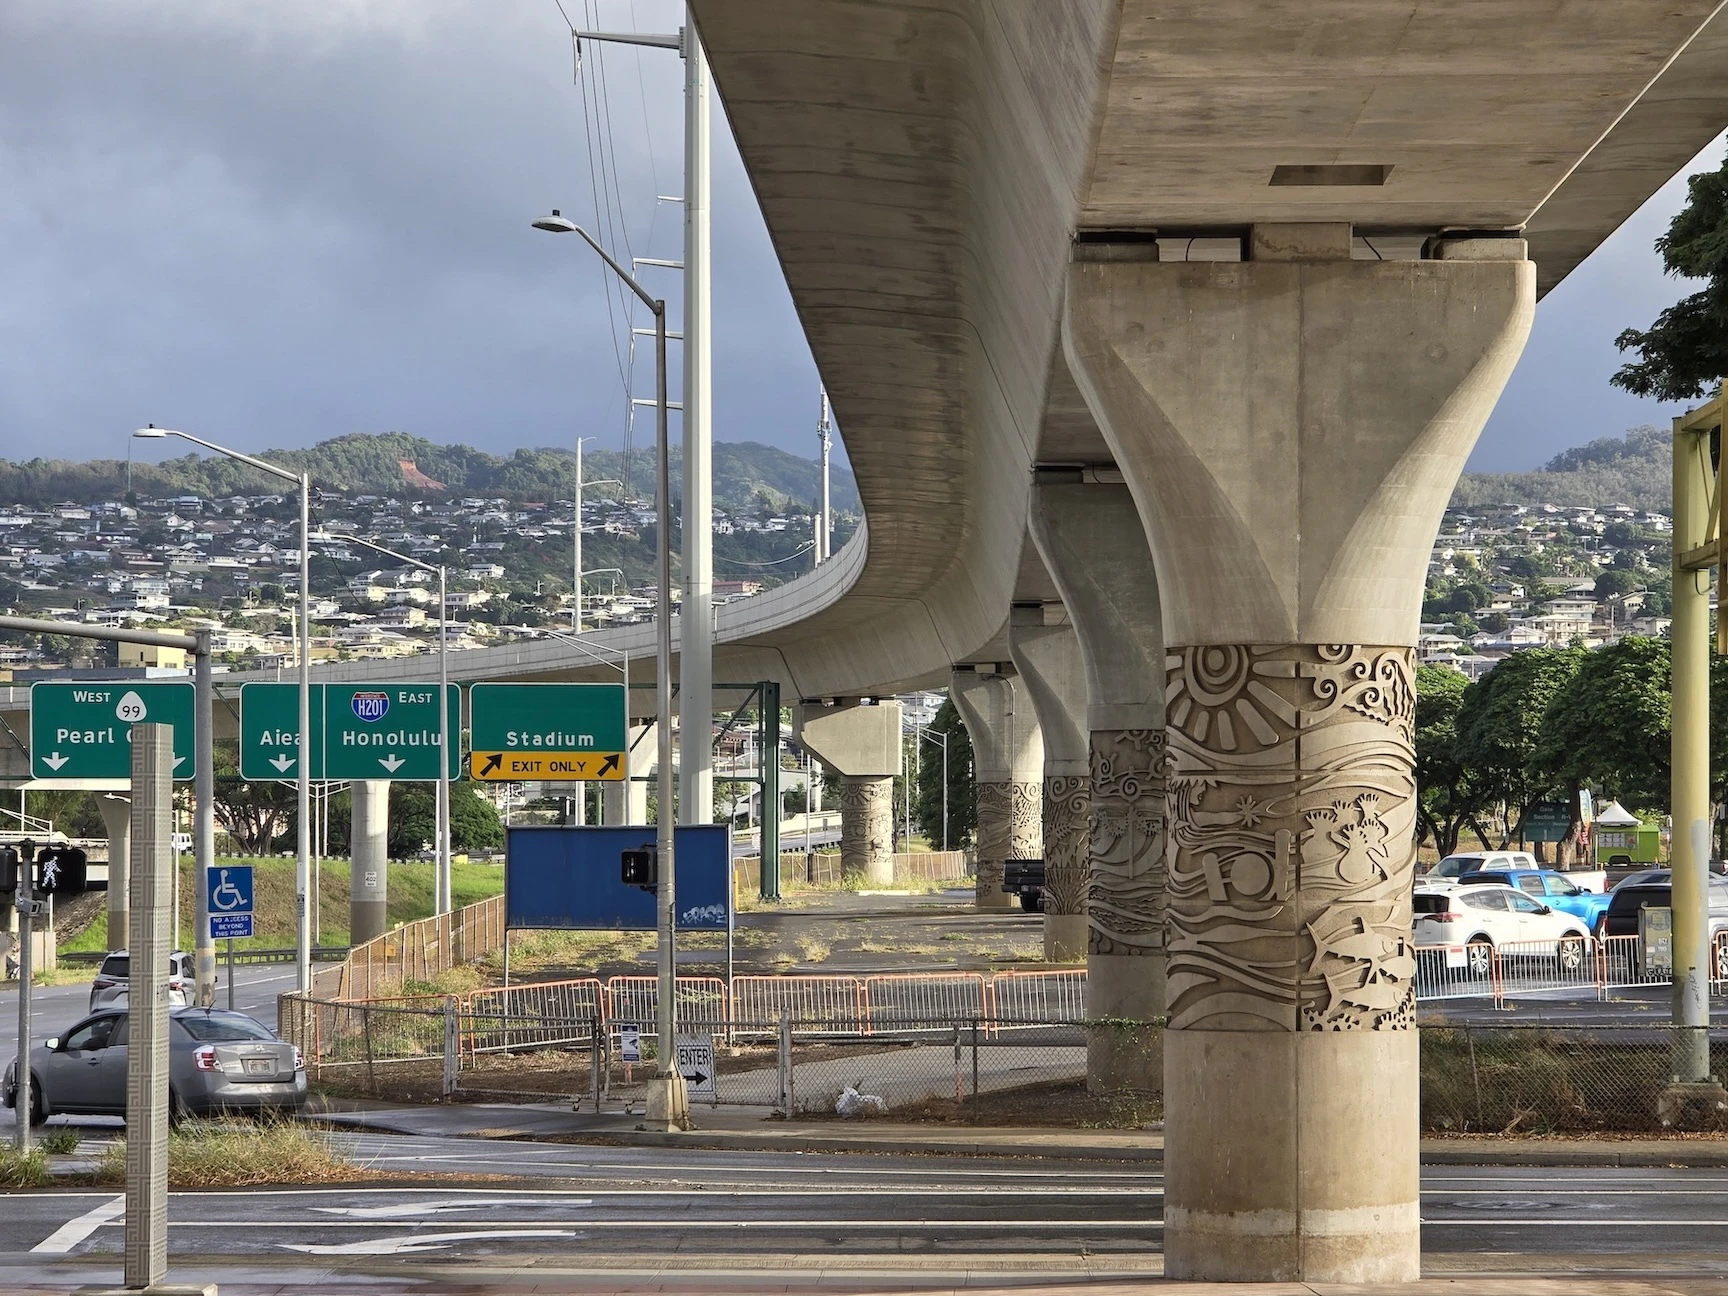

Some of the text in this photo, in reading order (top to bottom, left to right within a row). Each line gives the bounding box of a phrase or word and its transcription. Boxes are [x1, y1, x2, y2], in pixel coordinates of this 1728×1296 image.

[73, 690, 111, 703] WEST
[398, 691, 433, 704] EAST
[122, 705, 141, 718] 99
[358, 699, 383, 716] H201
[57, 727, 115, 744] Pearl
[342, 730, 441, 746] Honolulu
[506, 731, 594, 746] Stadium
[512, 761, 587, 772] EXIT ONLY
[679, 1048, 709, 1066] ENTER
